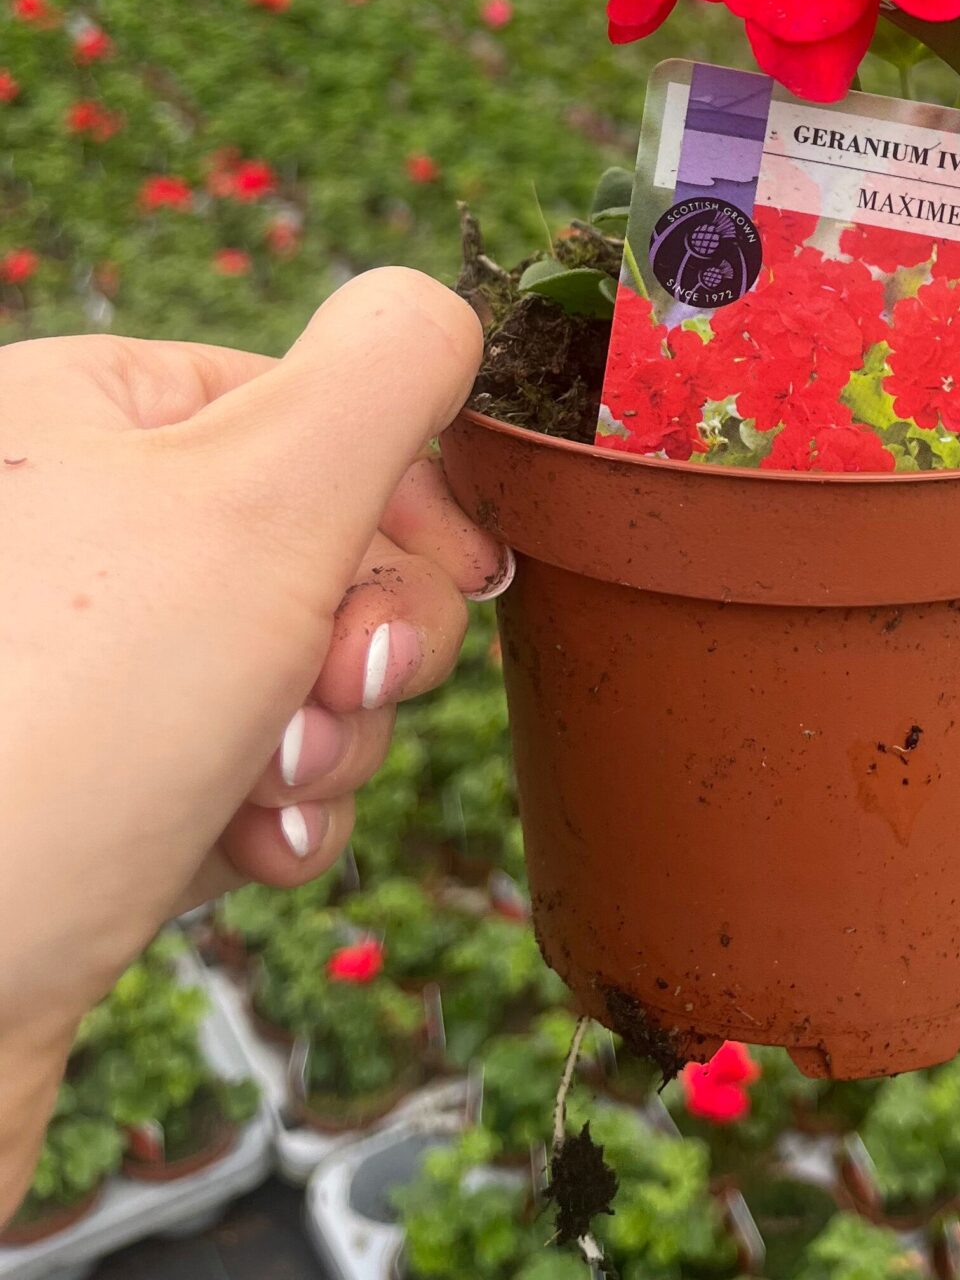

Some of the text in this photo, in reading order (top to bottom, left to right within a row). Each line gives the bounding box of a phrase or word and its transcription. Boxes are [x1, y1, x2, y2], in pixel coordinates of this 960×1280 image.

[793, 125, 930, 167] GERANIUM
[667, 201, 757, 244] SCOTTISH GROWN
[666, 278, 734, 302] SINCE 1972
